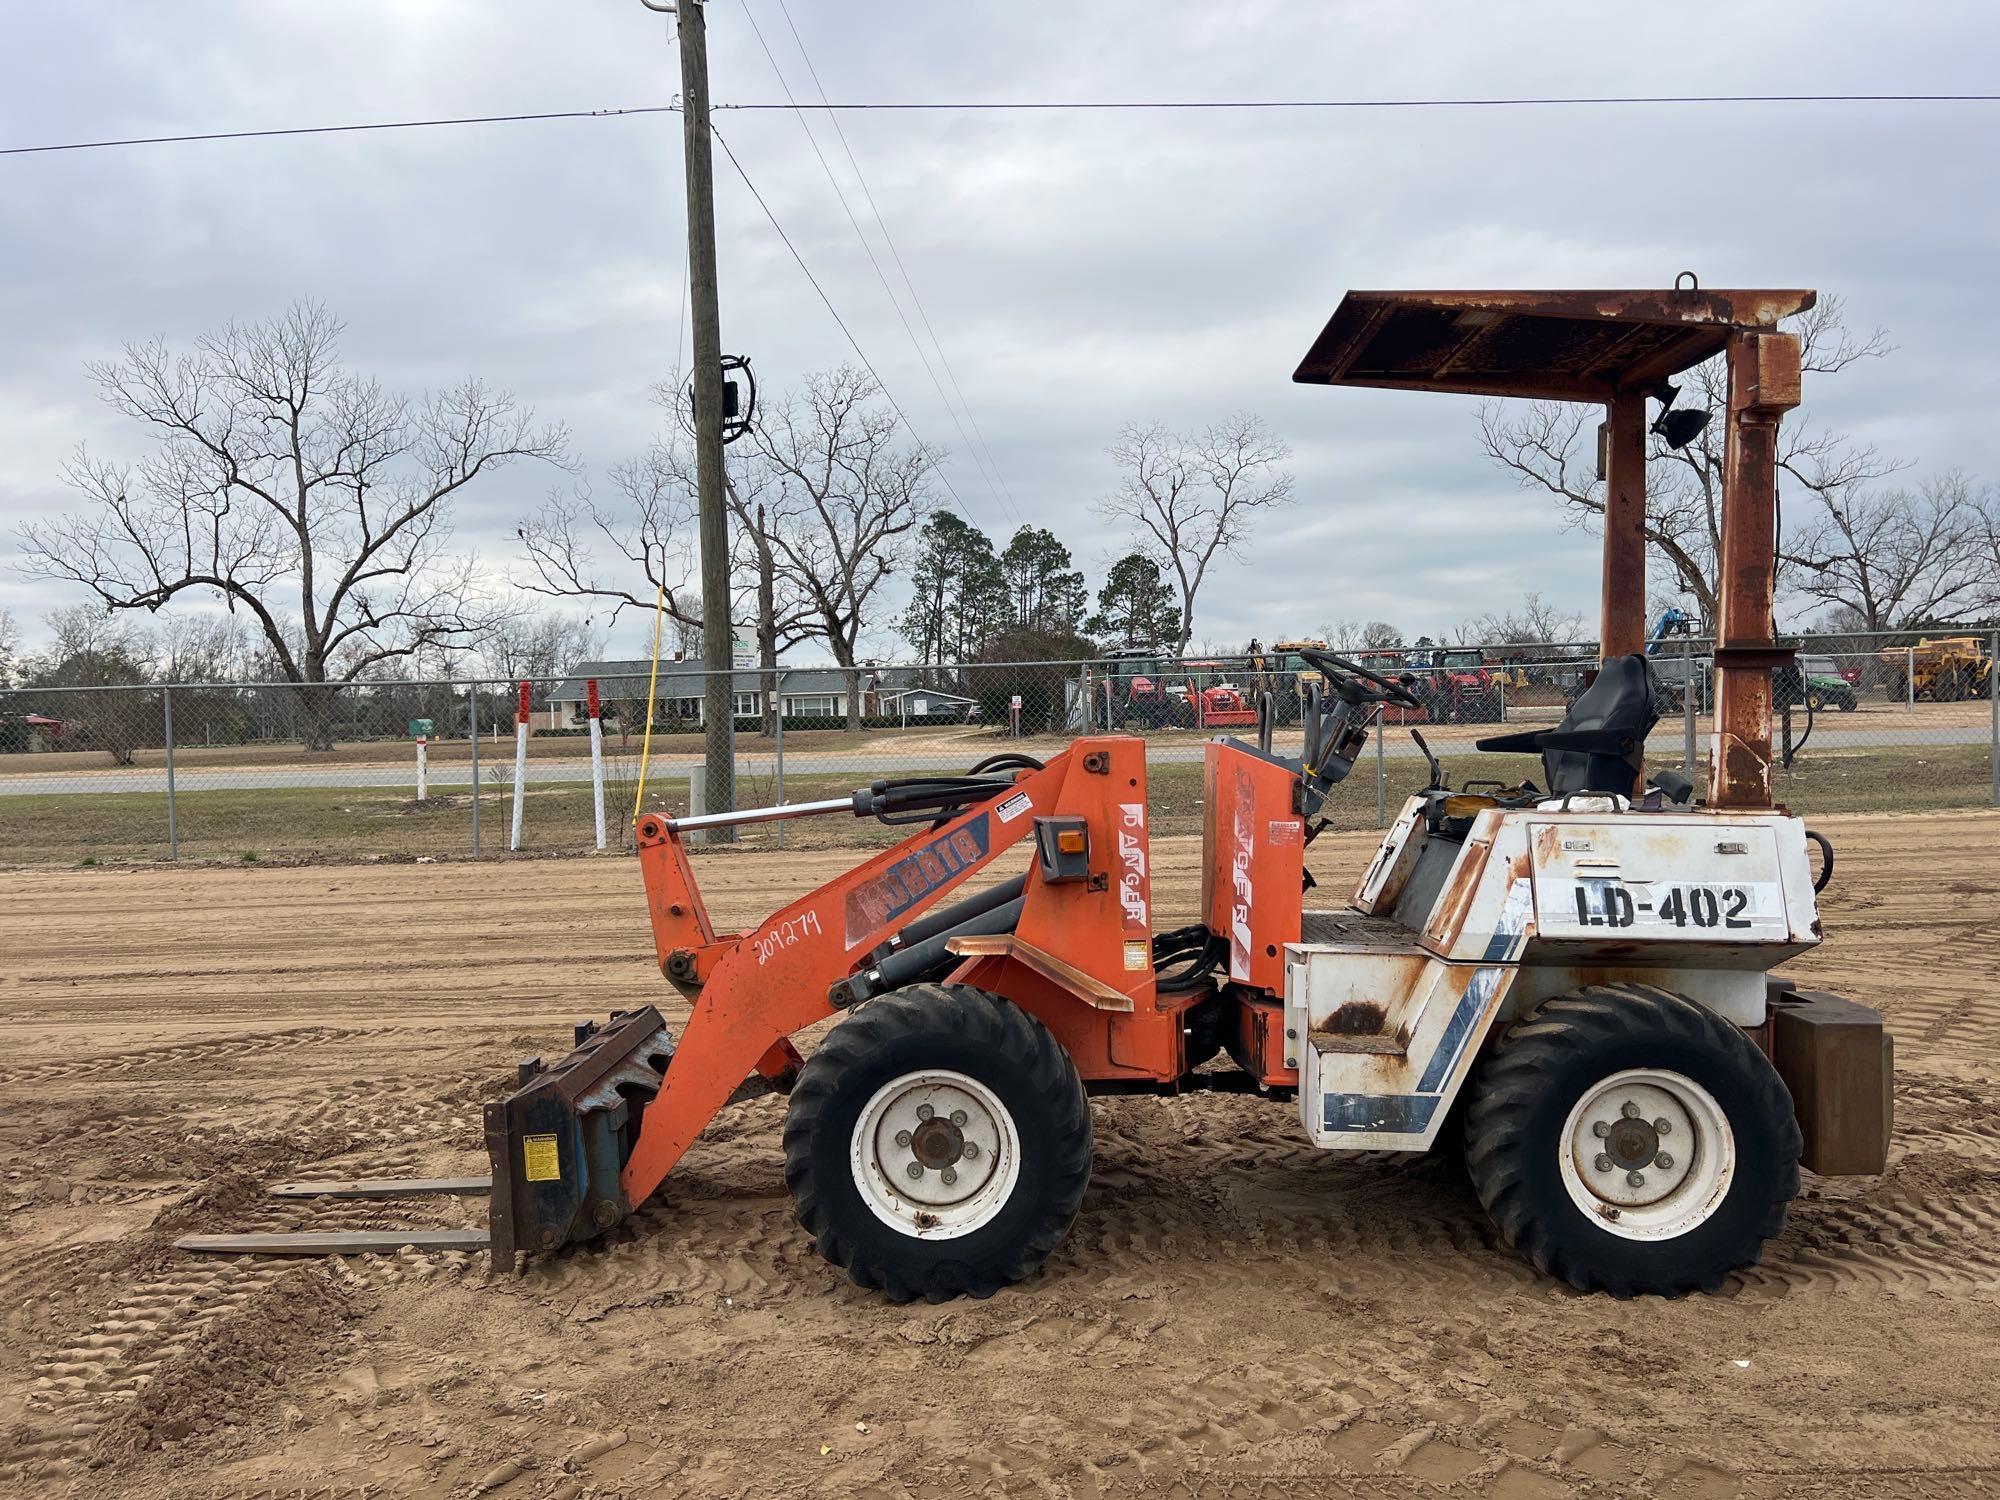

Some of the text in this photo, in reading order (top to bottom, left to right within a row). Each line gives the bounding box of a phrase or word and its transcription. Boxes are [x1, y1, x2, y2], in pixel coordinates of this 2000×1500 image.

[856, 829, 982, 923] KUBOTA
[1123, 814, 1141, 920] DANGER
[755, 910, 822, 965] 209279
[1575, 887, 1752, 928] LD-402
